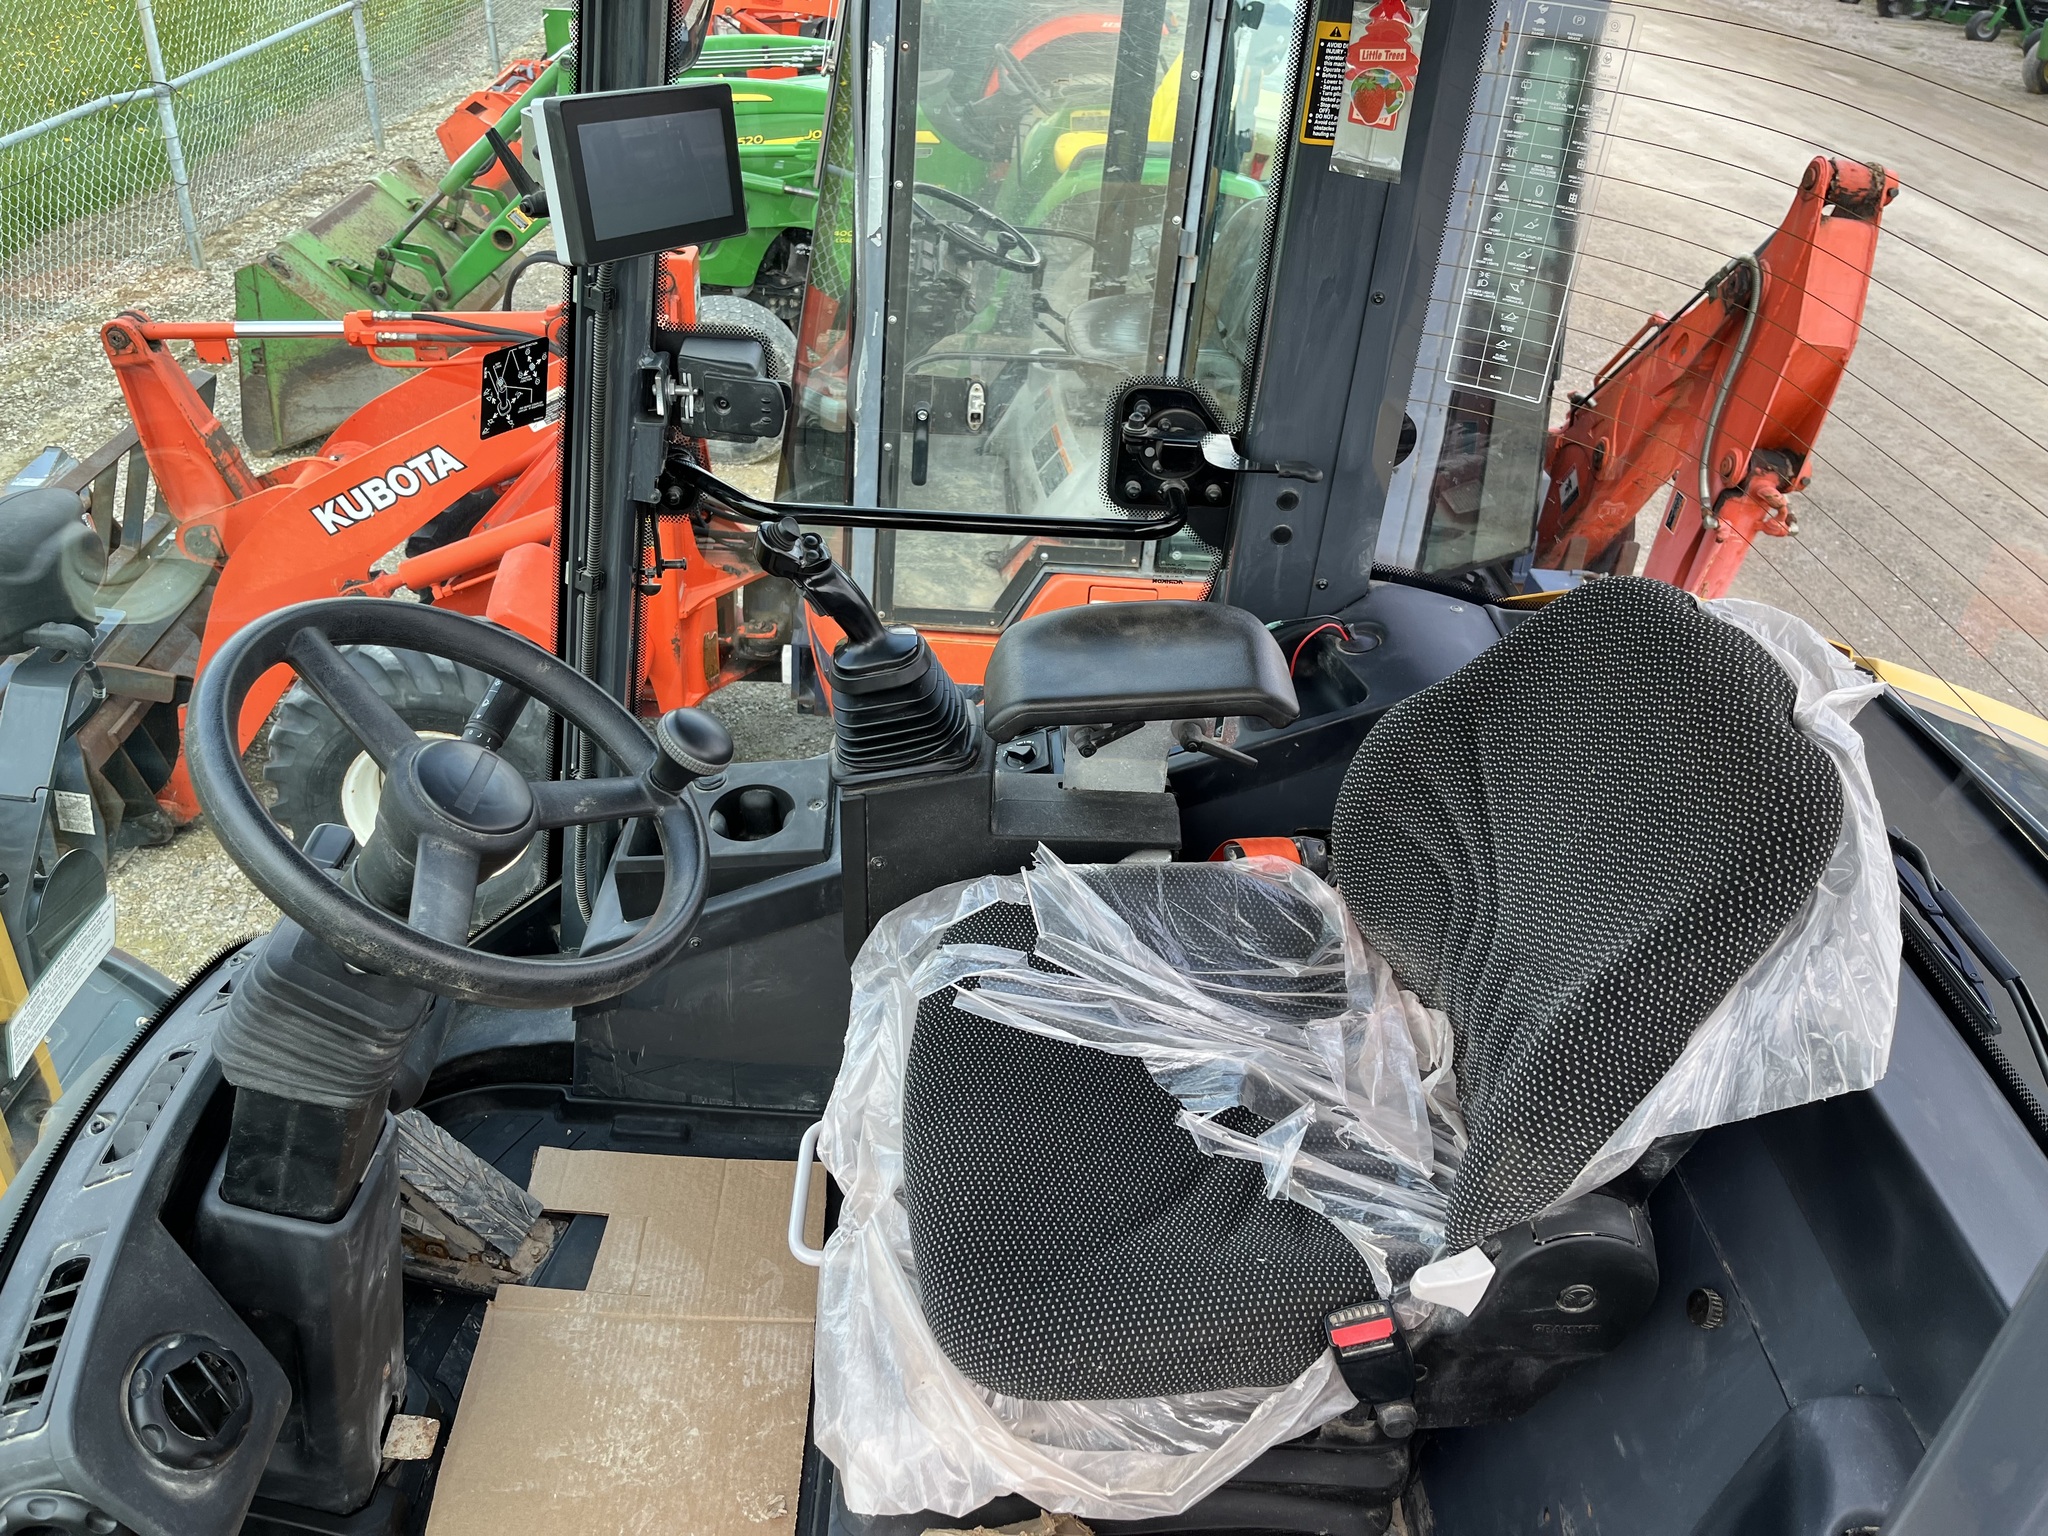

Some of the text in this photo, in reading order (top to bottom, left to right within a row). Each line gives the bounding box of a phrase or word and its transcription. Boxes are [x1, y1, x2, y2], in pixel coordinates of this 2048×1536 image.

[1362, 49, 1405, 60] Little Trees
[309, 445, 468, 536] KUBOTA
